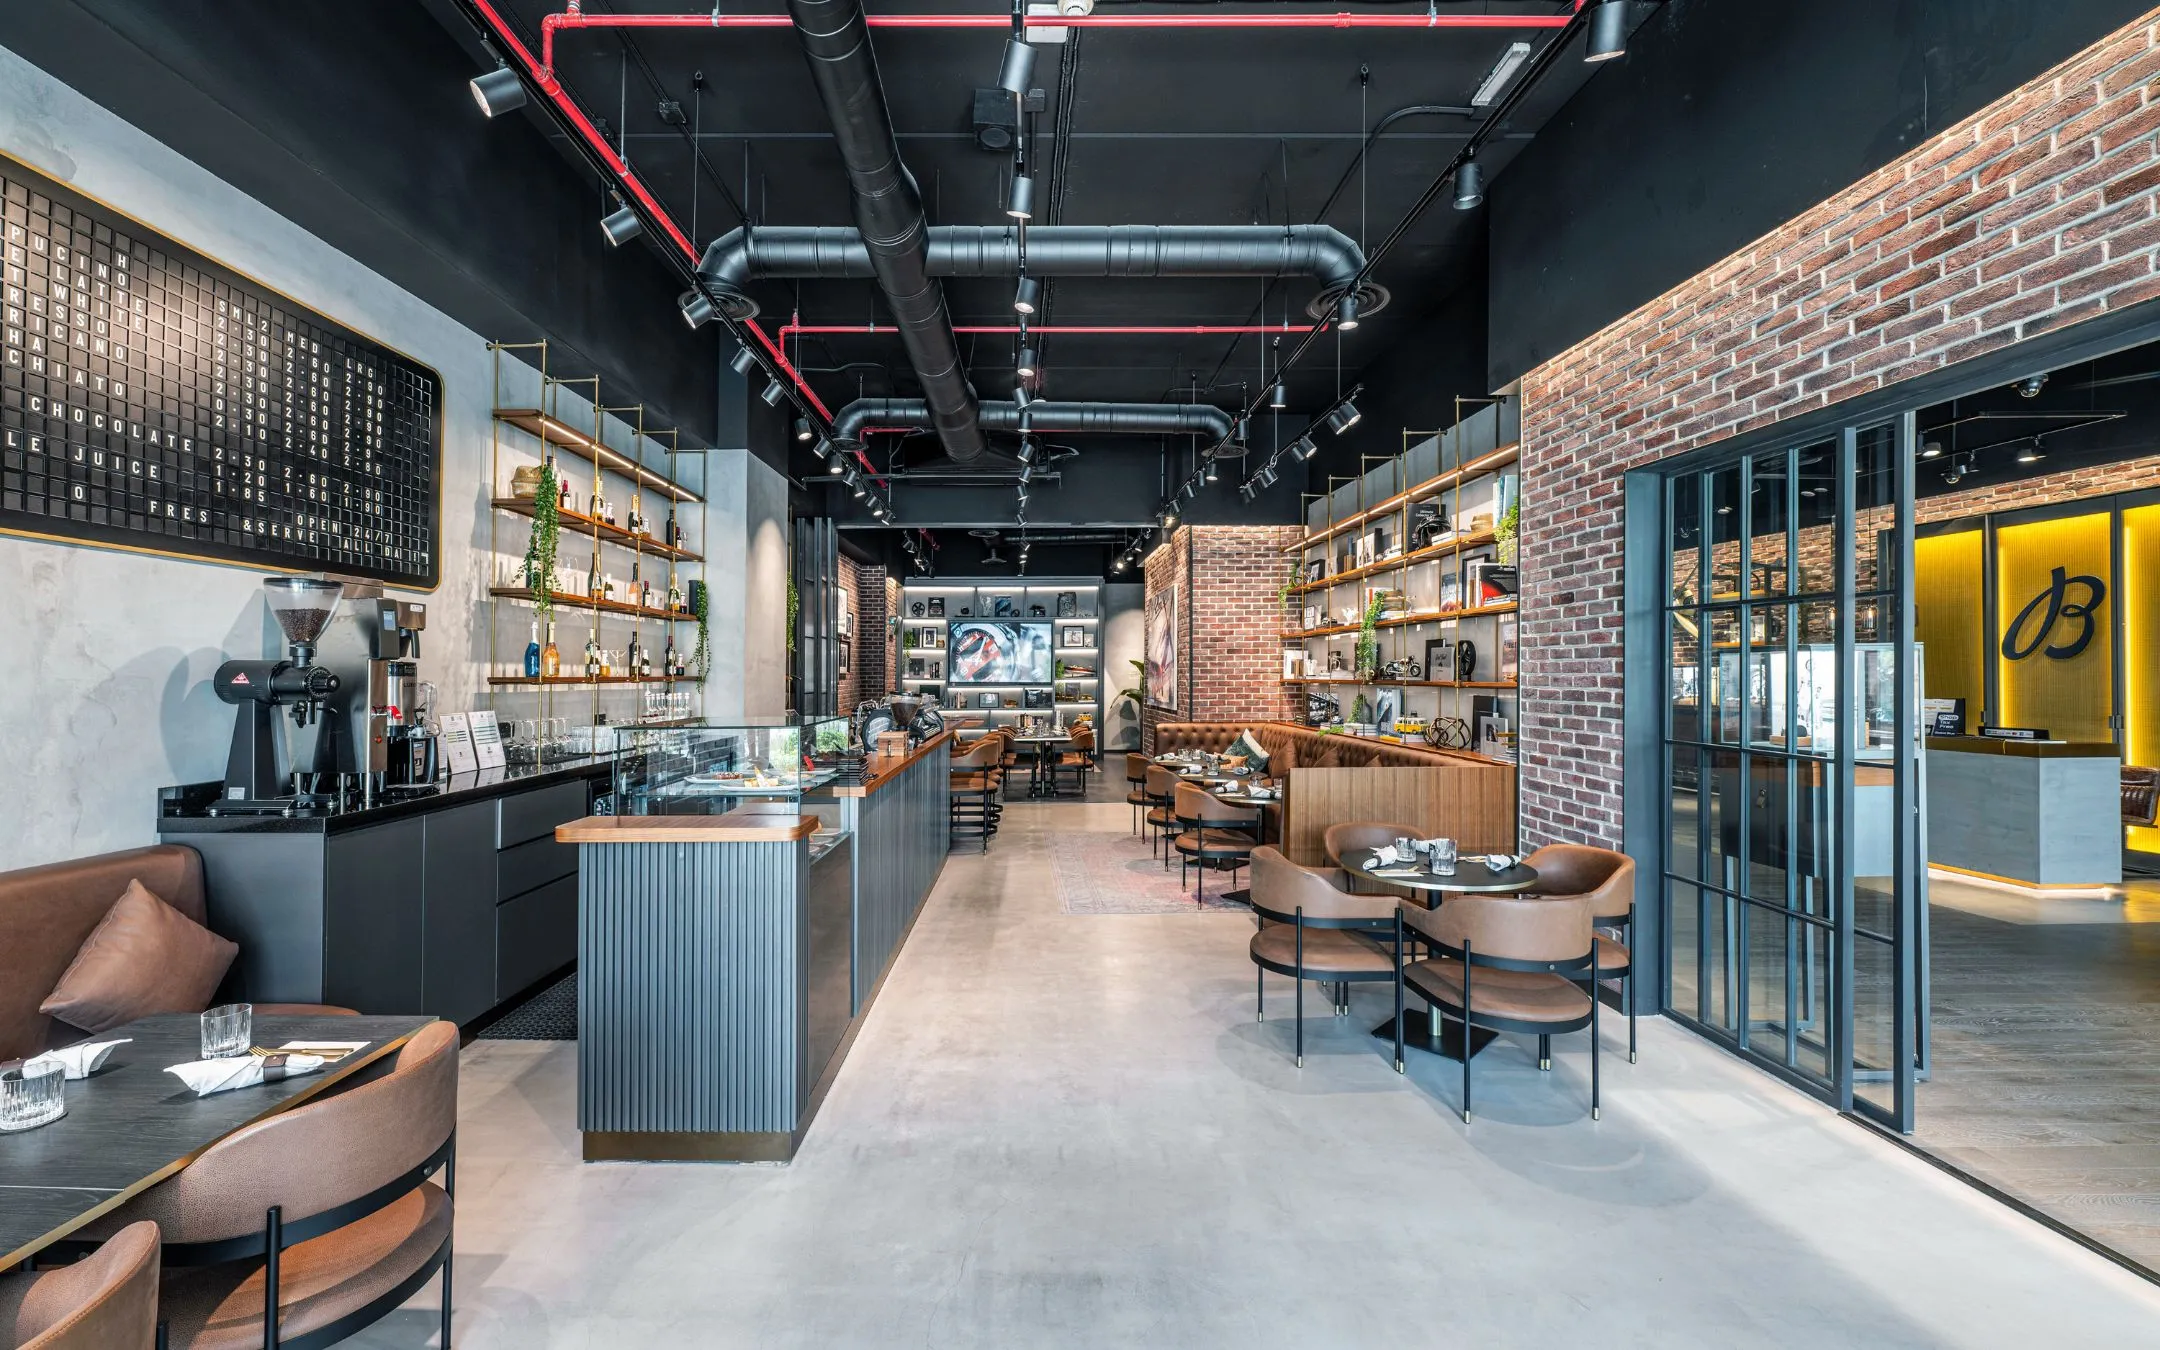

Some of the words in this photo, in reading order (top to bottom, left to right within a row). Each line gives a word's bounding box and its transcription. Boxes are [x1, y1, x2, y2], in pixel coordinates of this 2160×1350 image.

[53, 283, 142, 330] WHITE
[217, 348, 267, 378] 2.30
[286, 376, 329, 402] 2.60
[345, 400, 382, 422] 2.90
[56, 265, 143, 313] LATTE
[217, 333, 267, 362] 2.30
[286, 361, 329, 388] 2.60
[345, 386, 383, 409] 2.90
[217, 316, 267, 347] 2.30
[287, 347, 330, 374] 2.60
[345, 372, 383, 396] 2.90
[287, 331, 318, 354] MED
[346, 358, 373, 378] LRG
[216, 365, 267, 393] 2.30
[286, 391, 329, 416] 2.60
[345, 413, 382, 436] 2.90
[216, 398, 266, 425] 0.30
[216, 382, 266, 409] 2.30
[285, 406, 328, 431] 2.60
[344, 427, 381, 449] 2.90
[31, 396, 191, 452] CHOCOLATE
[215, 447, 265, 471] 2.30
[284, 467, 327, 488] 2.60
[343, 483, 380, 502] 2.90
[74, 447, 157, 478] JUICE
[216, 480, 265, 502] 1.85
[215, 414, 266, 440] 2.10
[285, 437, 328, 459] 2.40
[344, 455, 381, 475] 2.80
[216, 464, 265, 487] 1.20
[285, 482, 327, 502] 1.60
[344, 497, 381, 515] 1.90
[150, 500, 207, 523] FRES
[343, 539, 370, 553] ALL
[384, 546, 400, 559] DA
[297, 514, 338, 534] OPEN
[354, 527, 390, 544] 24/7
